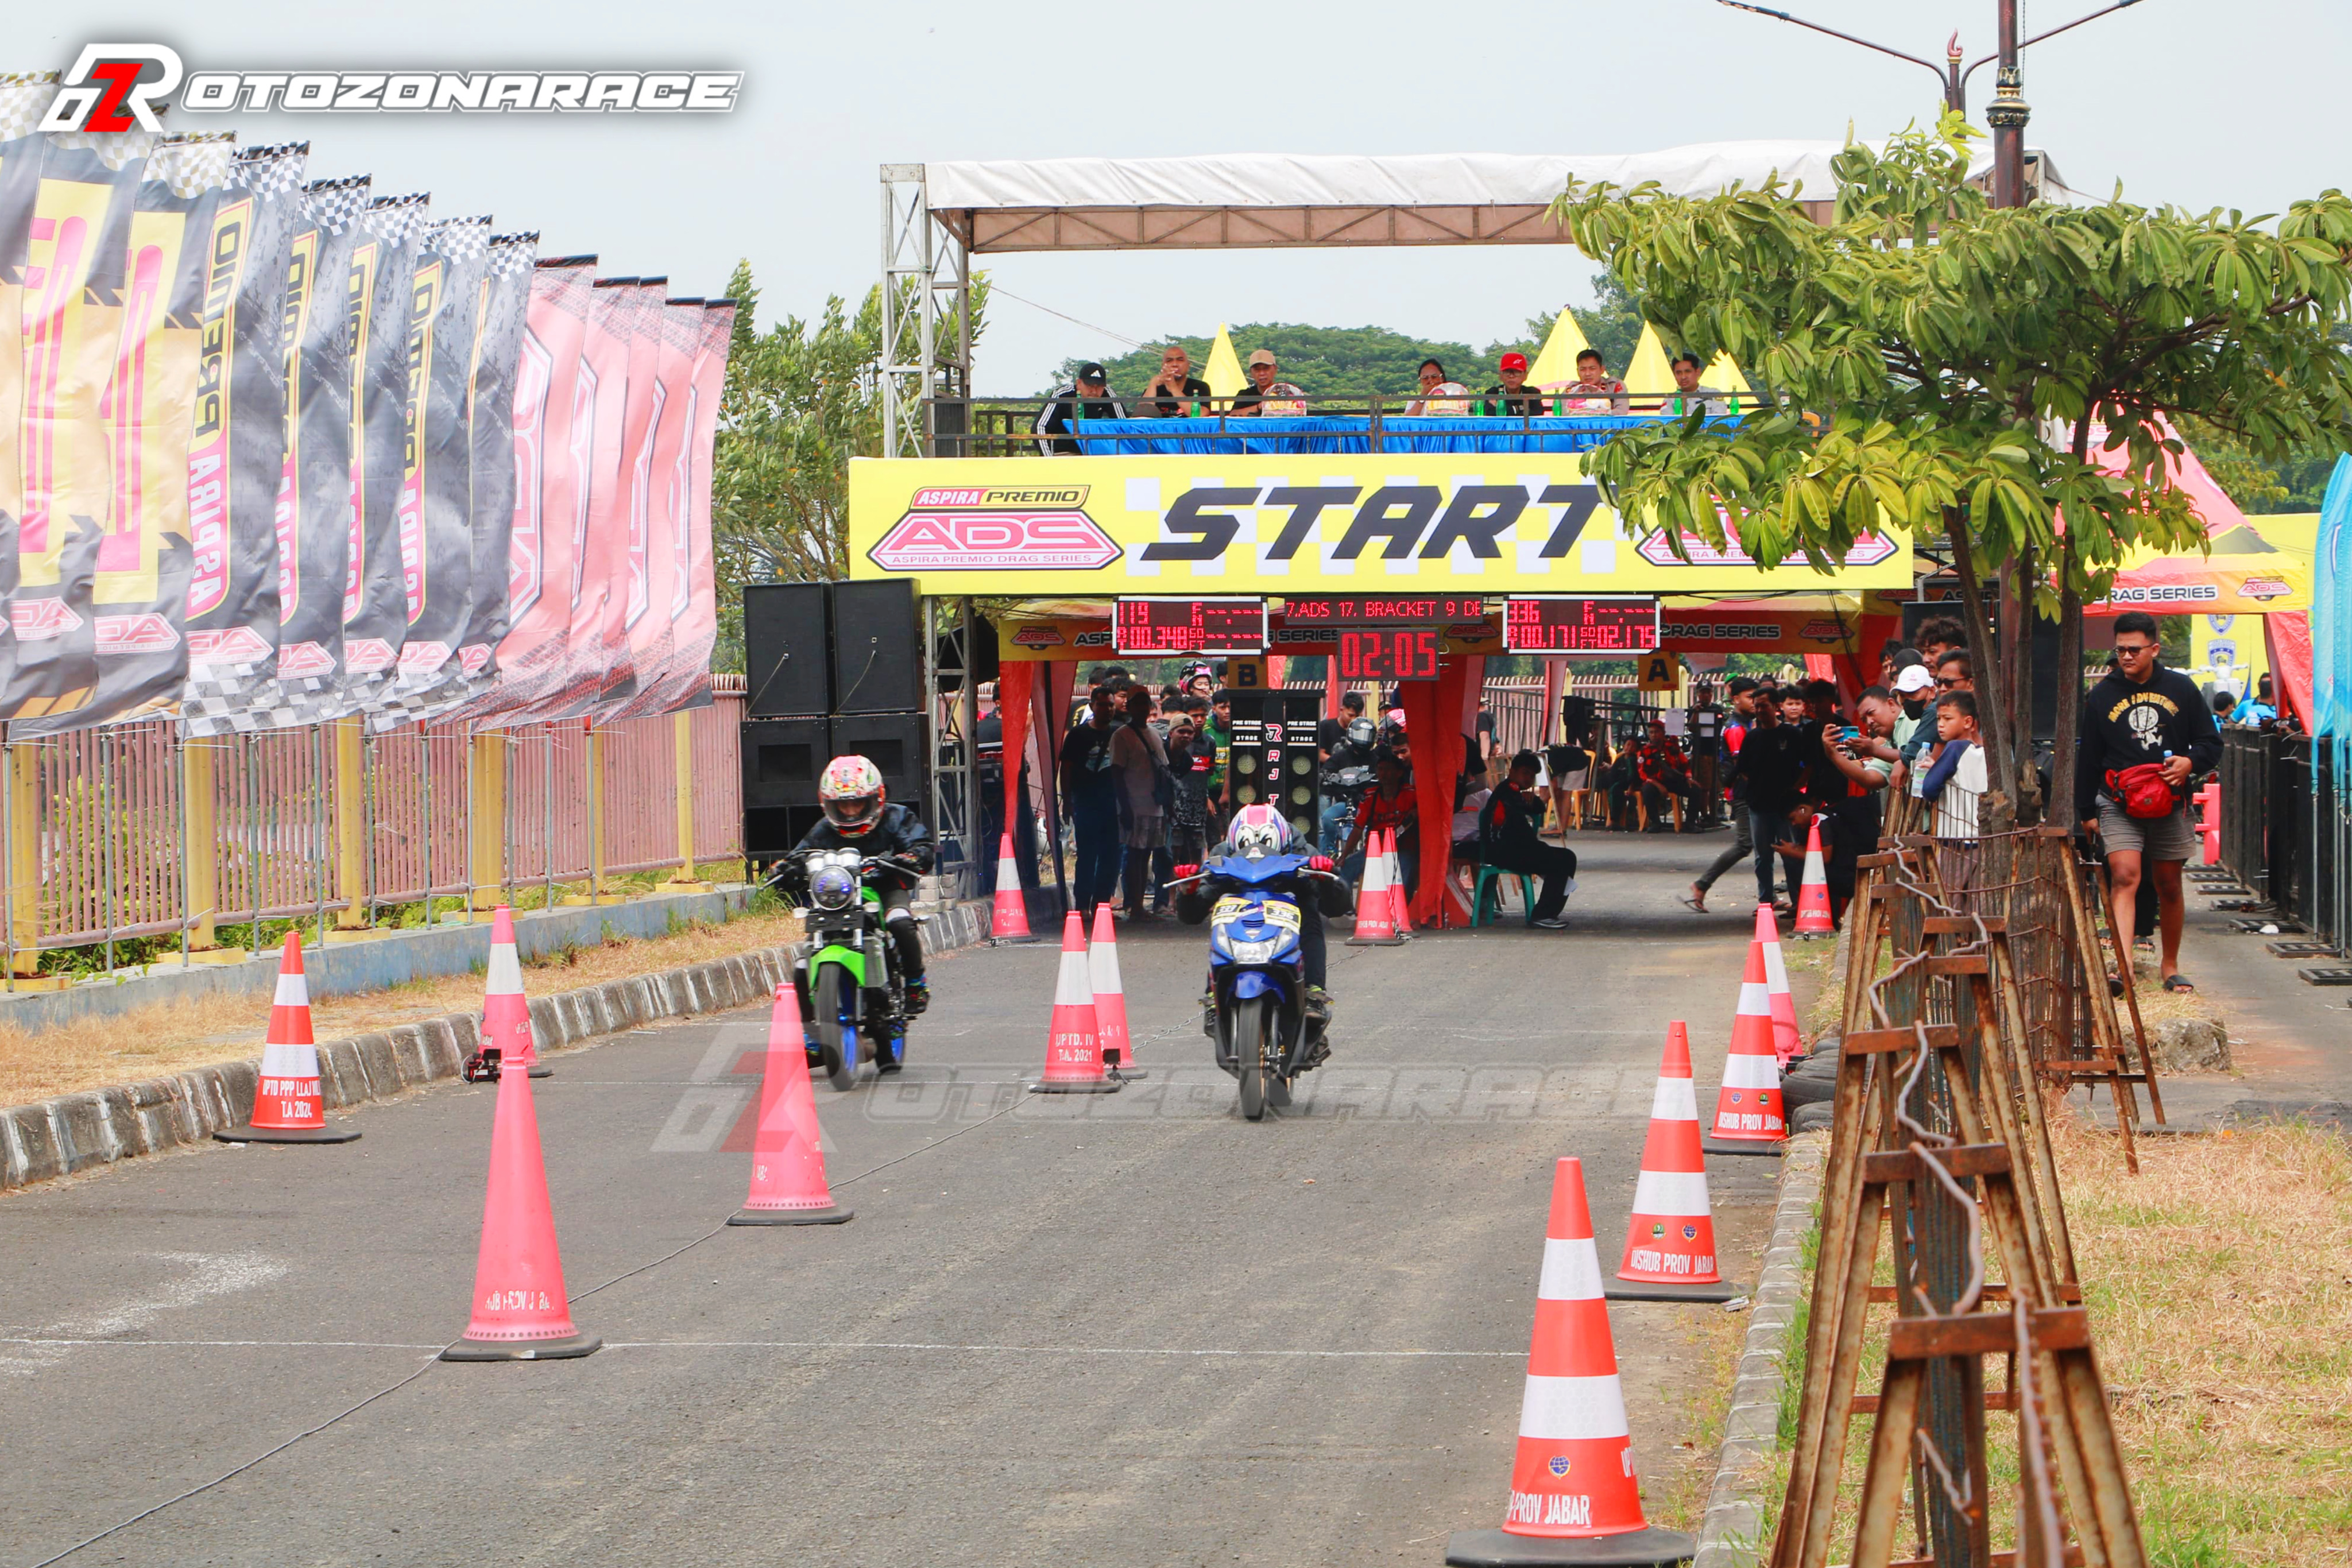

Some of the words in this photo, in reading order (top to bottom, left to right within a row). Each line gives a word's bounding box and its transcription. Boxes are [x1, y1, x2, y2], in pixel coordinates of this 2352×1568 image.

[919, 491, 980, 505] ASPIRA
[986, 491, 1080, 502] PREMIO
[1139, 485, 1617, 560] START
[887, 520, 1104, 551] ADS
[892, 555, 939, 564] ASPIRA
[943, 555, 993, 563] PREMIO
[997, 555, 1038, 563] DRAG
[1043, 554, 1092, 562] SERIES
[2096, 589, 2144, 601] RAG
[2150, 587, 2215, 600] SERIES
[1119, 602, 1148, 624] 119
[1365, 601, 1436, 617] BRACKET
[1445, 601, 1455, 617] 9
[1507, 601, 1540, 623] 336
[1129, 626, 1187, 649] 00.348
[1521, 625, 1577, 648] 00.171
[1597, 625, 1655, 648] 02.175
[1714, 625, 1780, 638] SERIES
[1341, 633, 1436, 677] 02:05
[1237, 664, 1258, 687] B
[1647, 659, 1670, 682] A
[1085, 1033, 1094, 1046] IV
[1074, 1049, 1092, 1062] 2021
[280, 1080, 295, 1097] PPP
[295, 1100, 312, 1118] 2024
[1717, 1112, 1740, 1129] DISHUB
[1742, 1113, 1763, 1130] PROV
[1630, 1249, 1661, 1272] DISHUB
[1663, 1253, 1690, 1275] PROV
[1512, 1492, 1542, 1524] PROV
[1545, 1495, 1591, 1525] JABAR
